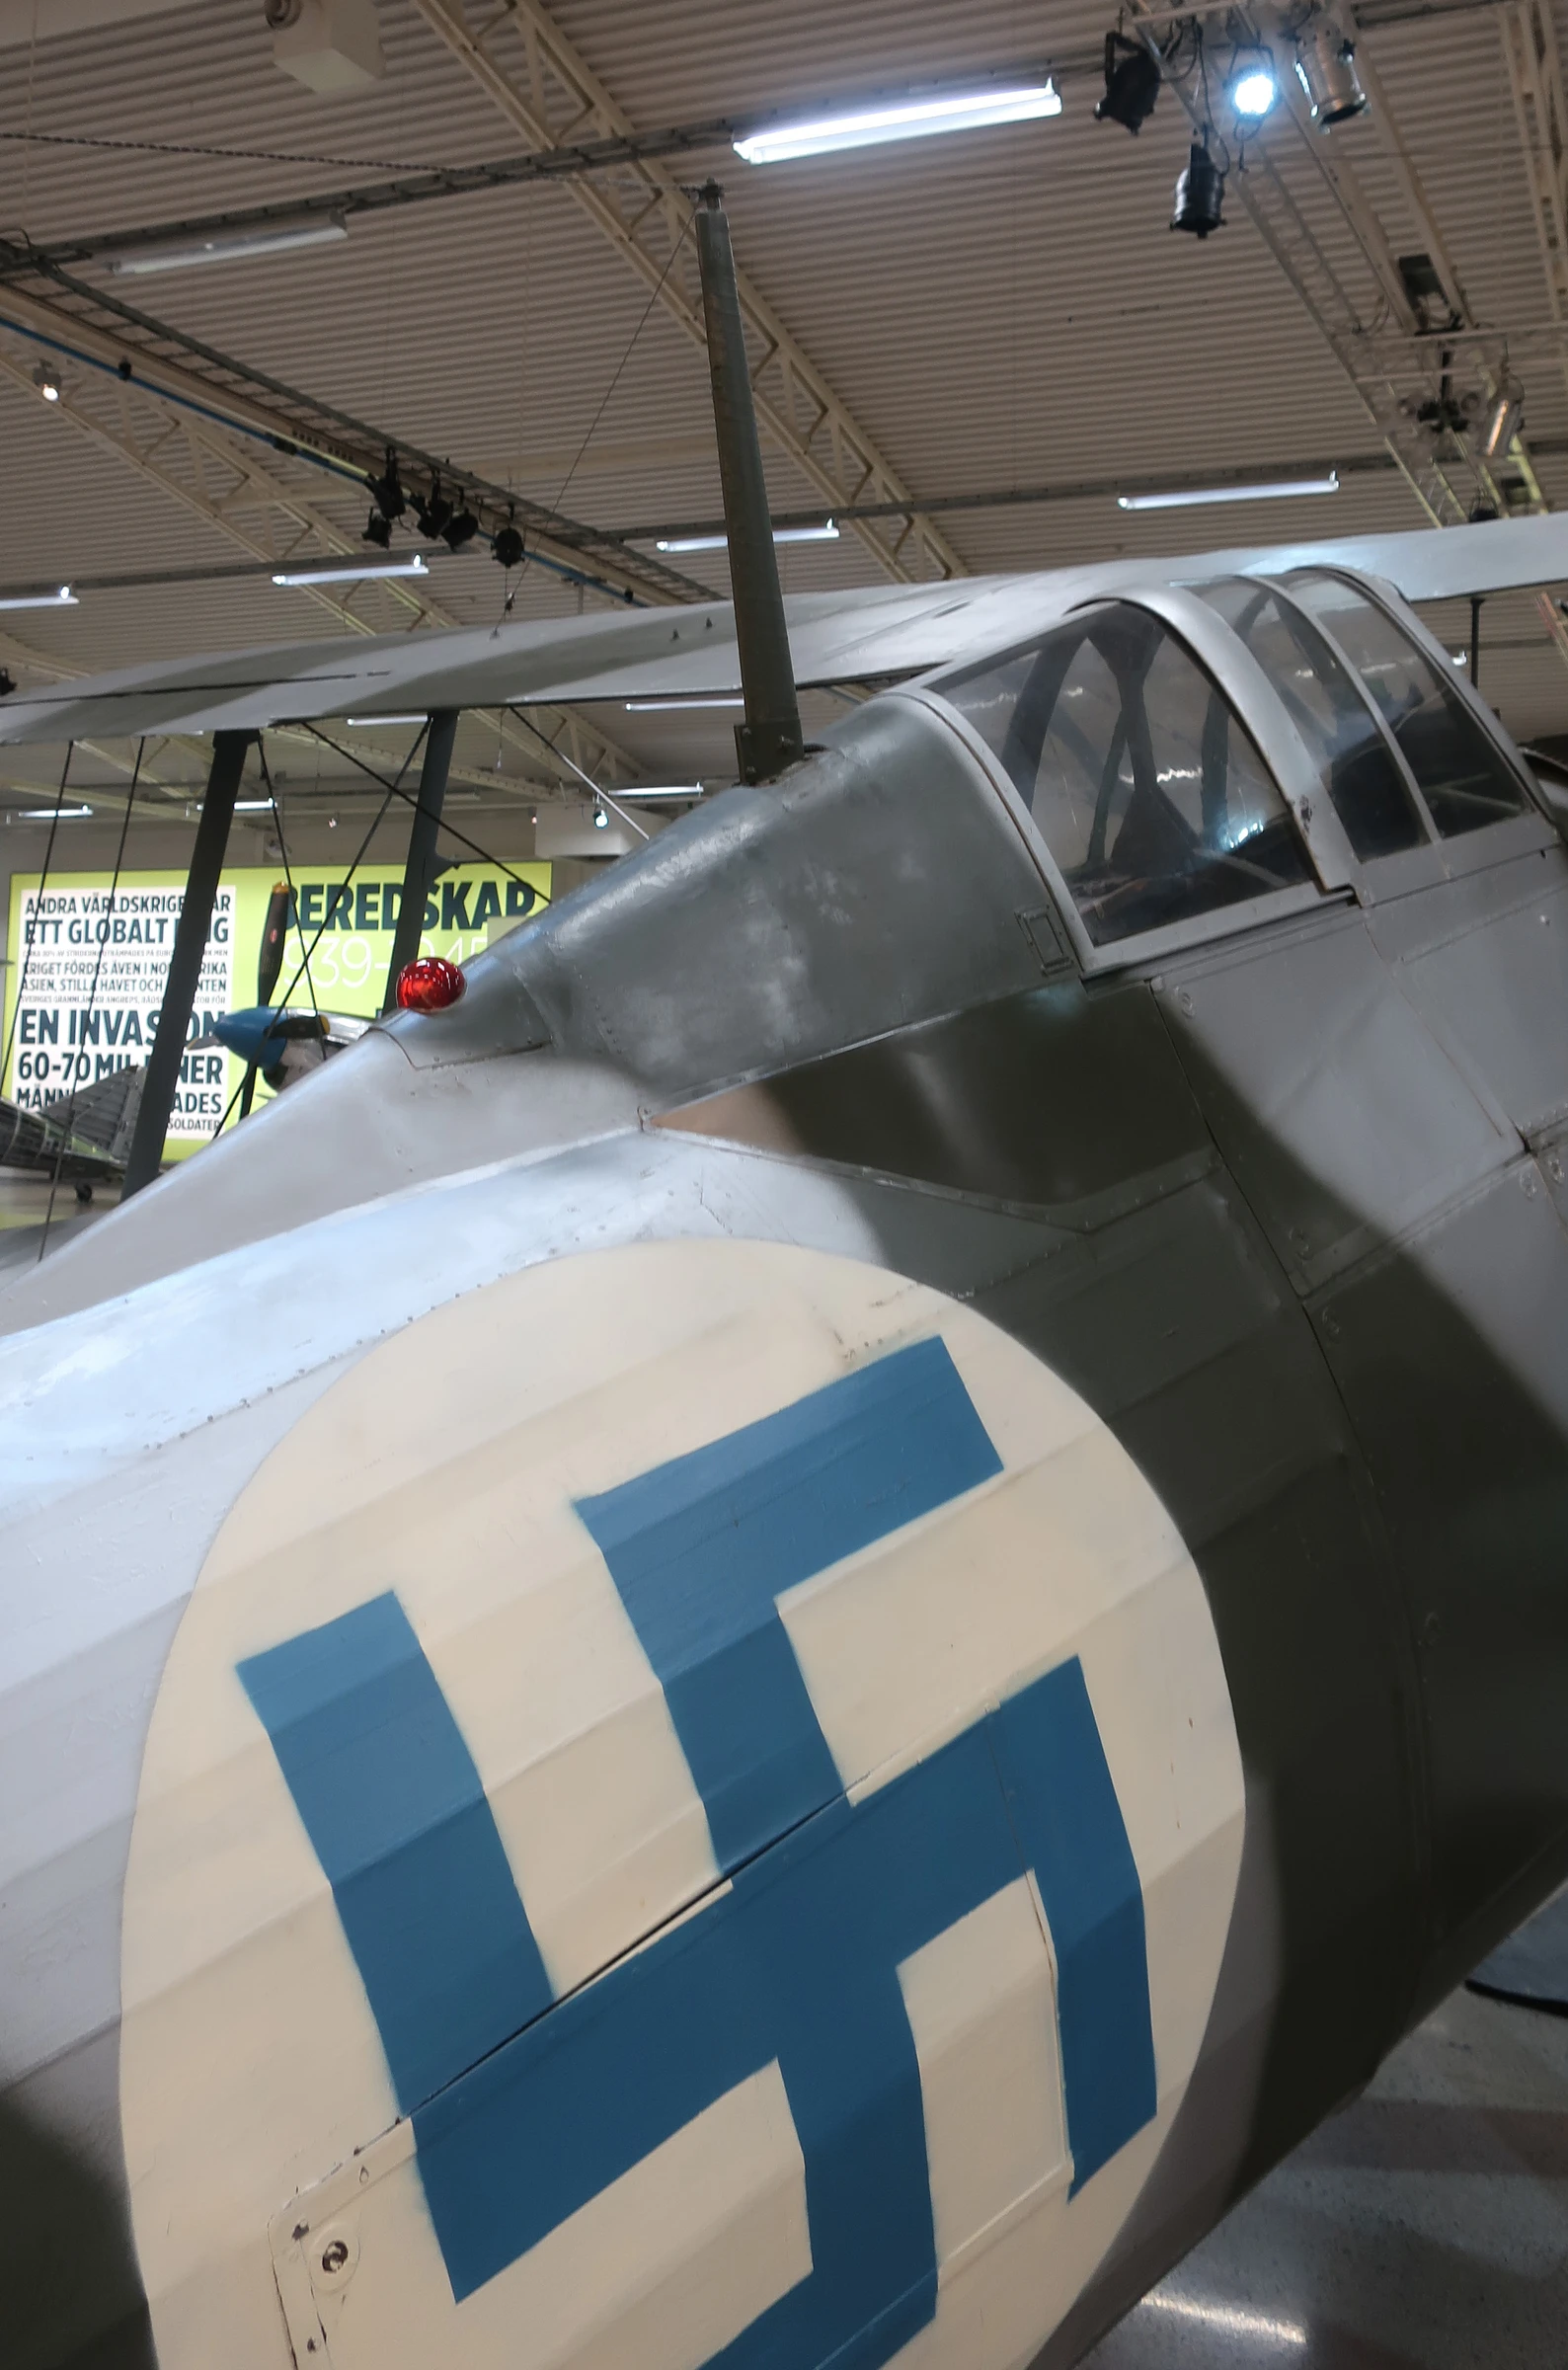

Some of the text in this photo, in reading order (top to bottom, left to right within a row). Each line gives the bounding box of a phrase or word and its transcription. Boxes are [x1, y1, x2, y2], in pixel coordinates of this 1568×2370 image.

[26, 897, 77, 914] ANDRA
[82, 892, 186, 914] VÄRLDSKRIGE
[25, 919, 63, 944] ETT
[68, 917, 168, 944] GLOBALT
[111, 959, 140, 975] ÄVEN
[100, 979, 137, 991] HAVET
[139, 979, 163, 991] OCH
[20, 1009, 226, 1046] EN INVASON
[19, 1052, 91, 1081] 60-70
